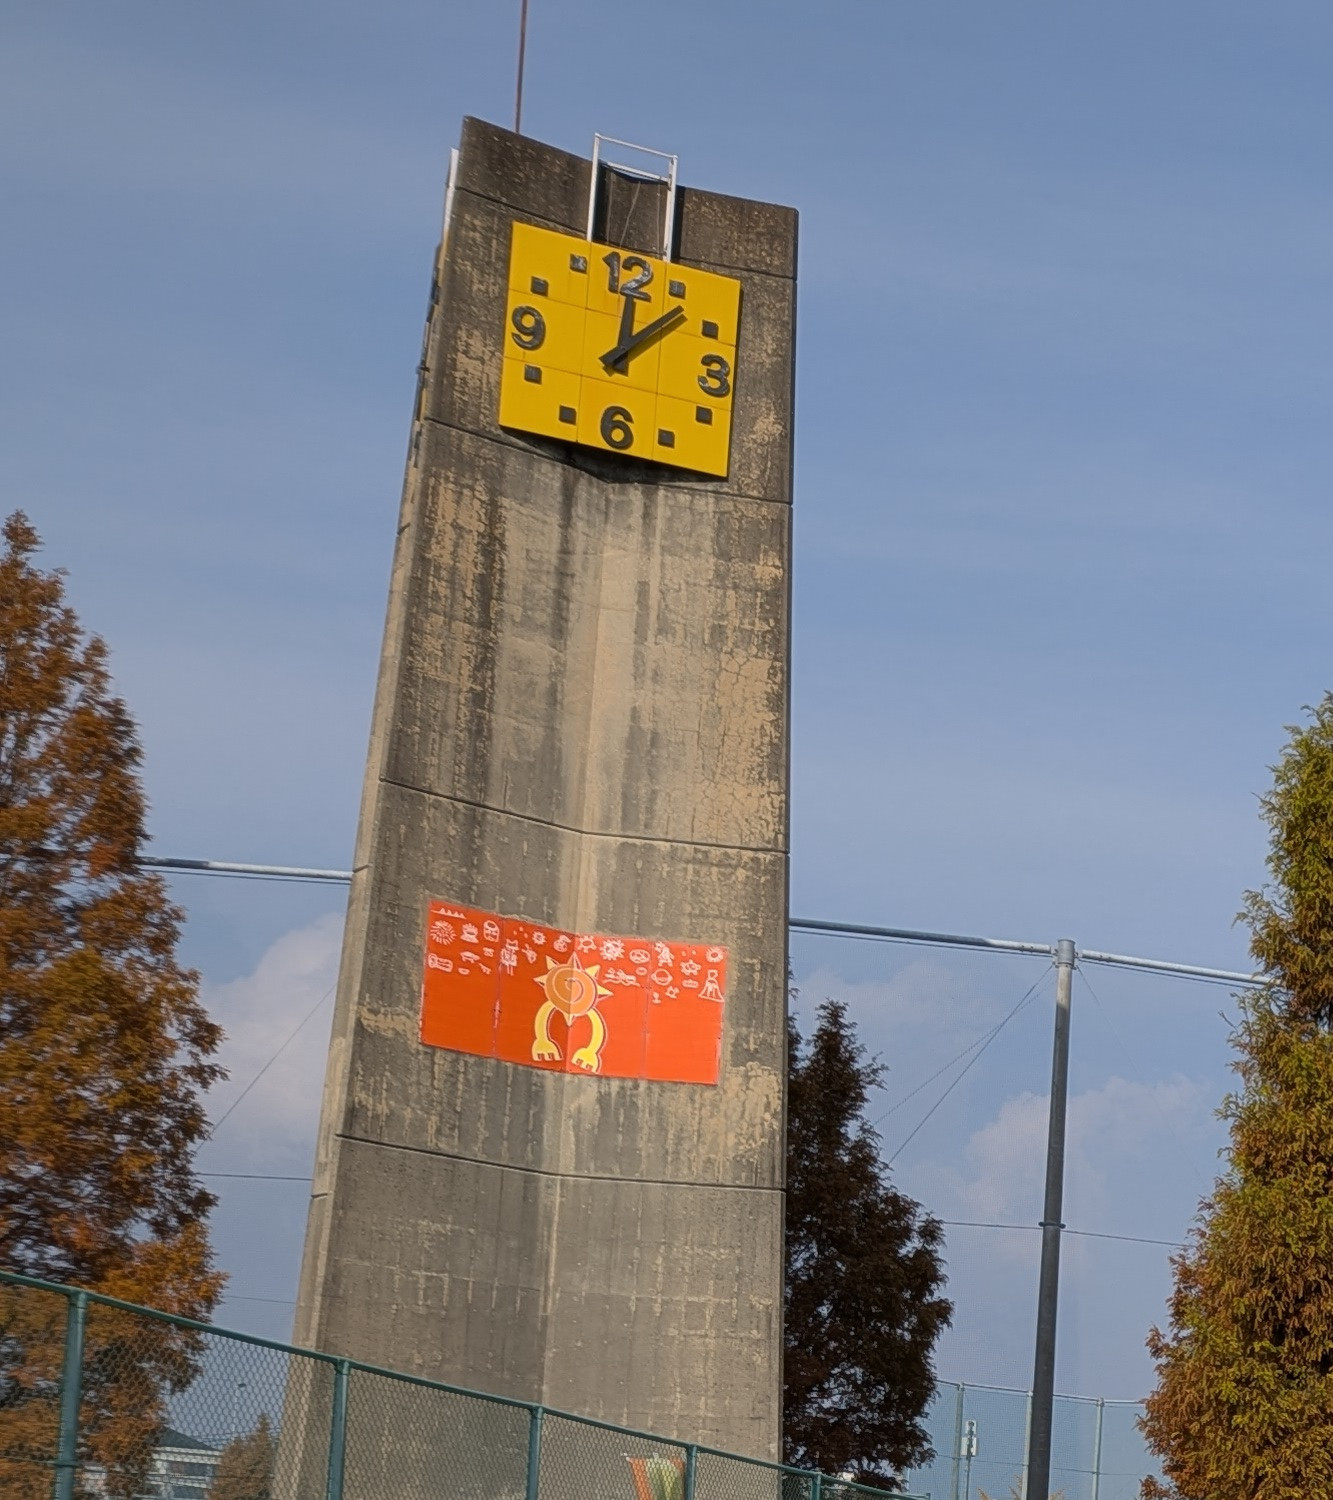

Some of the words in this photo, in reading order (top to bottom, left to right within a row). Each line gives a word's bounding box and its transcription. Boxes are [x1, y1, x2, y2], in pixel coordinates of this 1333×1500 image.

[602, 251, 654, 300] 12
[511, 306, 546, 351] 9
[697, 354, 731, 397] 3
[600, 406, 634, 450] 6
